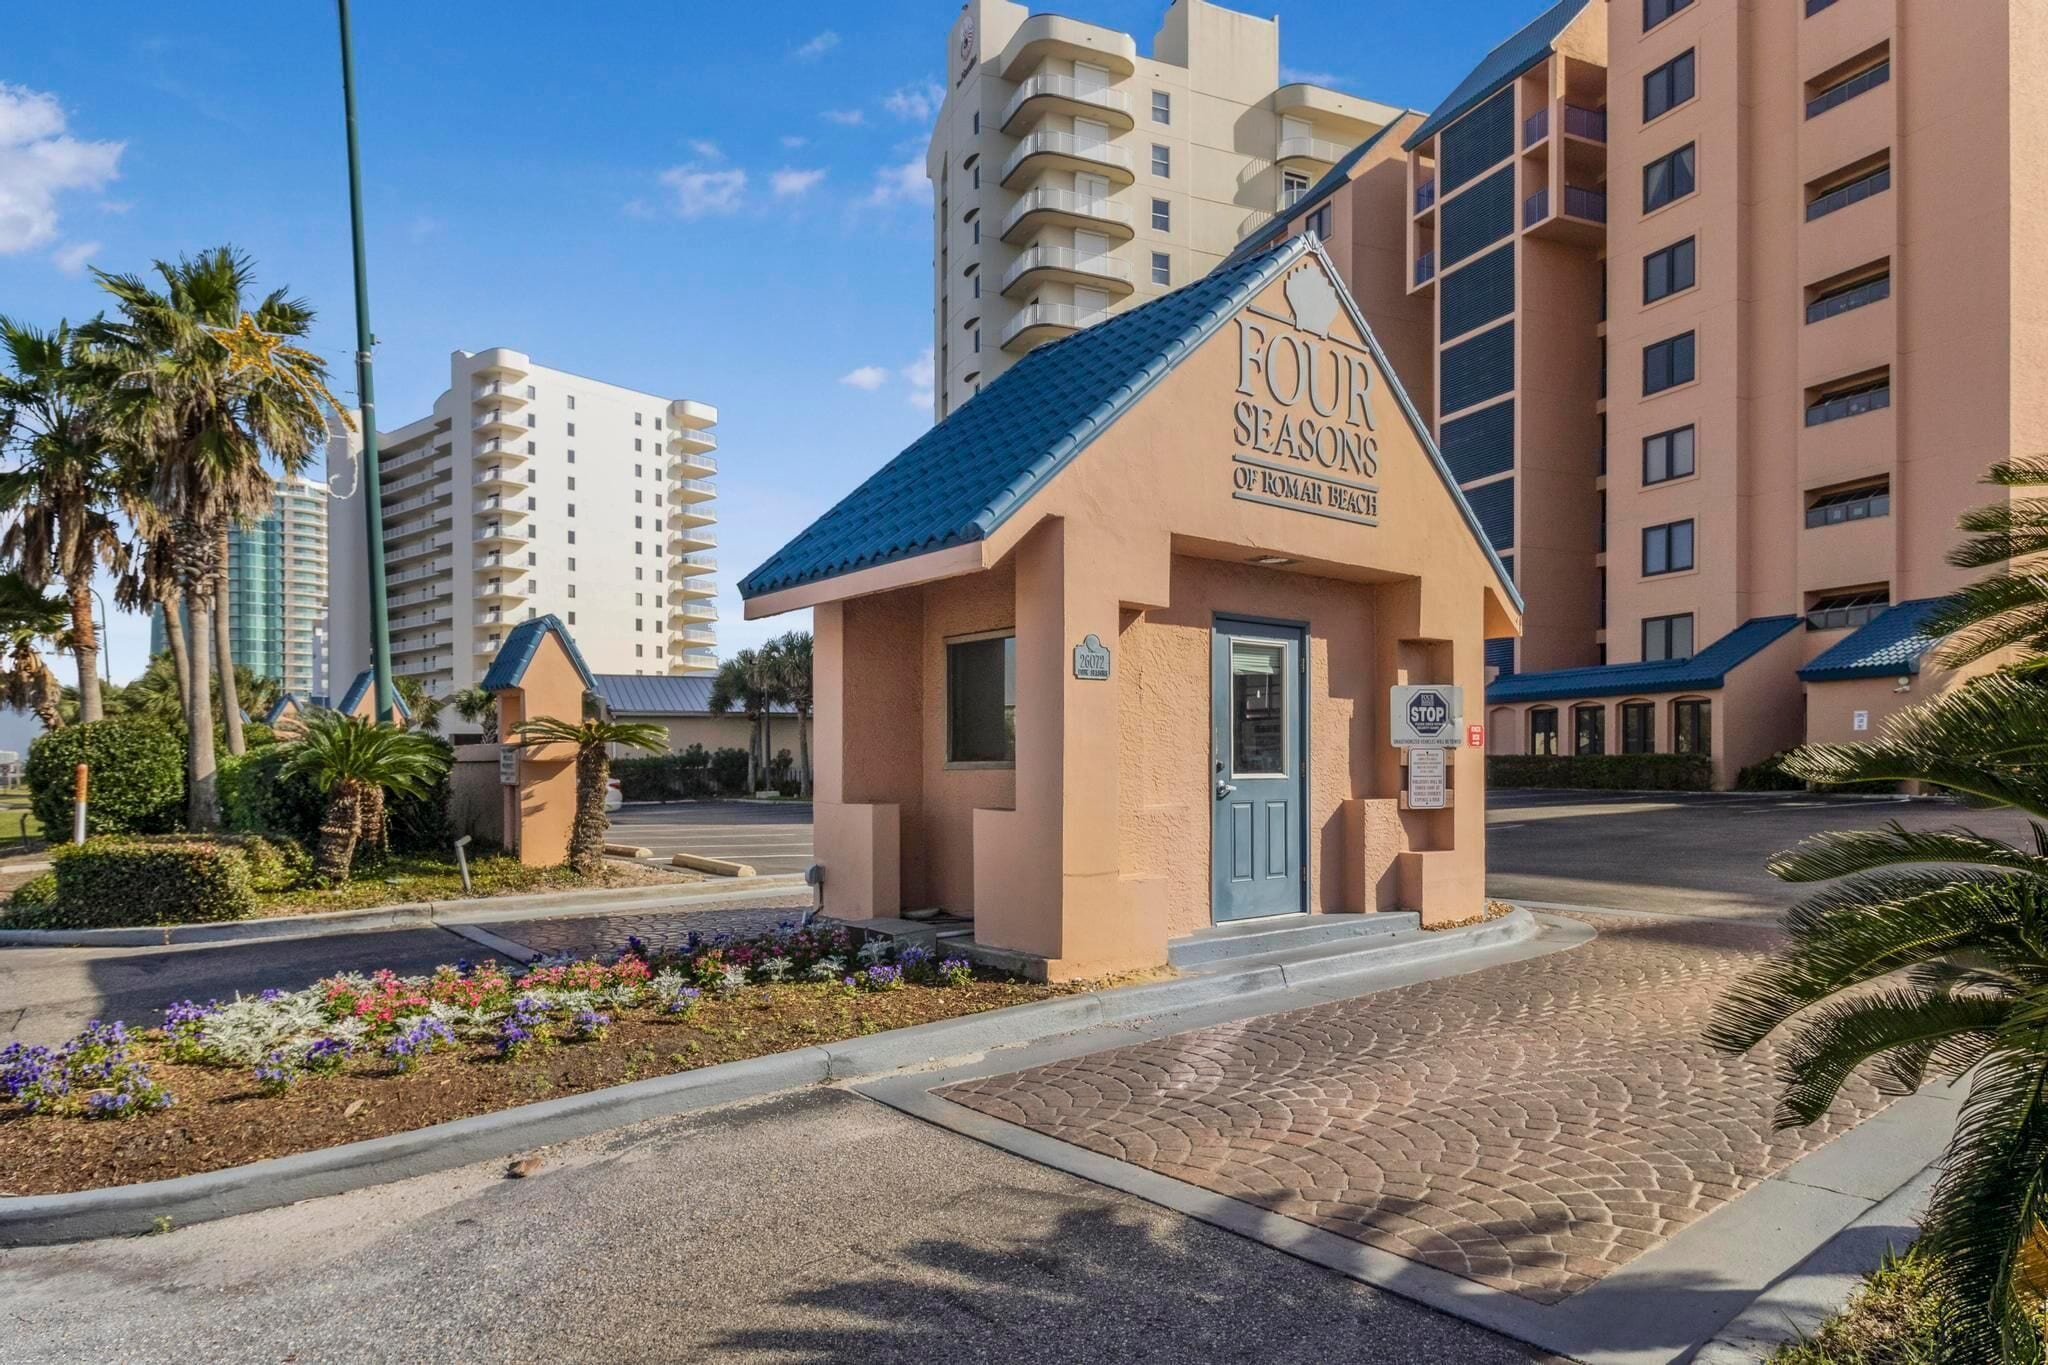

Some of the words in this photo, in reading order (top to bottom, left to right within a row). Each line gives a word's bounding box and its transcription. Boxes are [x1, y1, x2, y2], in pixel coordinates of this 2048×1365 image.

[1234, 317, 1377, 431] FOUR
[1233, 400, 1379, 478] SEASONS
[1233, 466, 1258, 490] OF
[1261, 471, 1322, 505] ROMAR
[1327, 485, 1378, 516] BEACH
[1079, 654, 1105, 669] 26072
[1410, 706, 1445, 722] STOP
